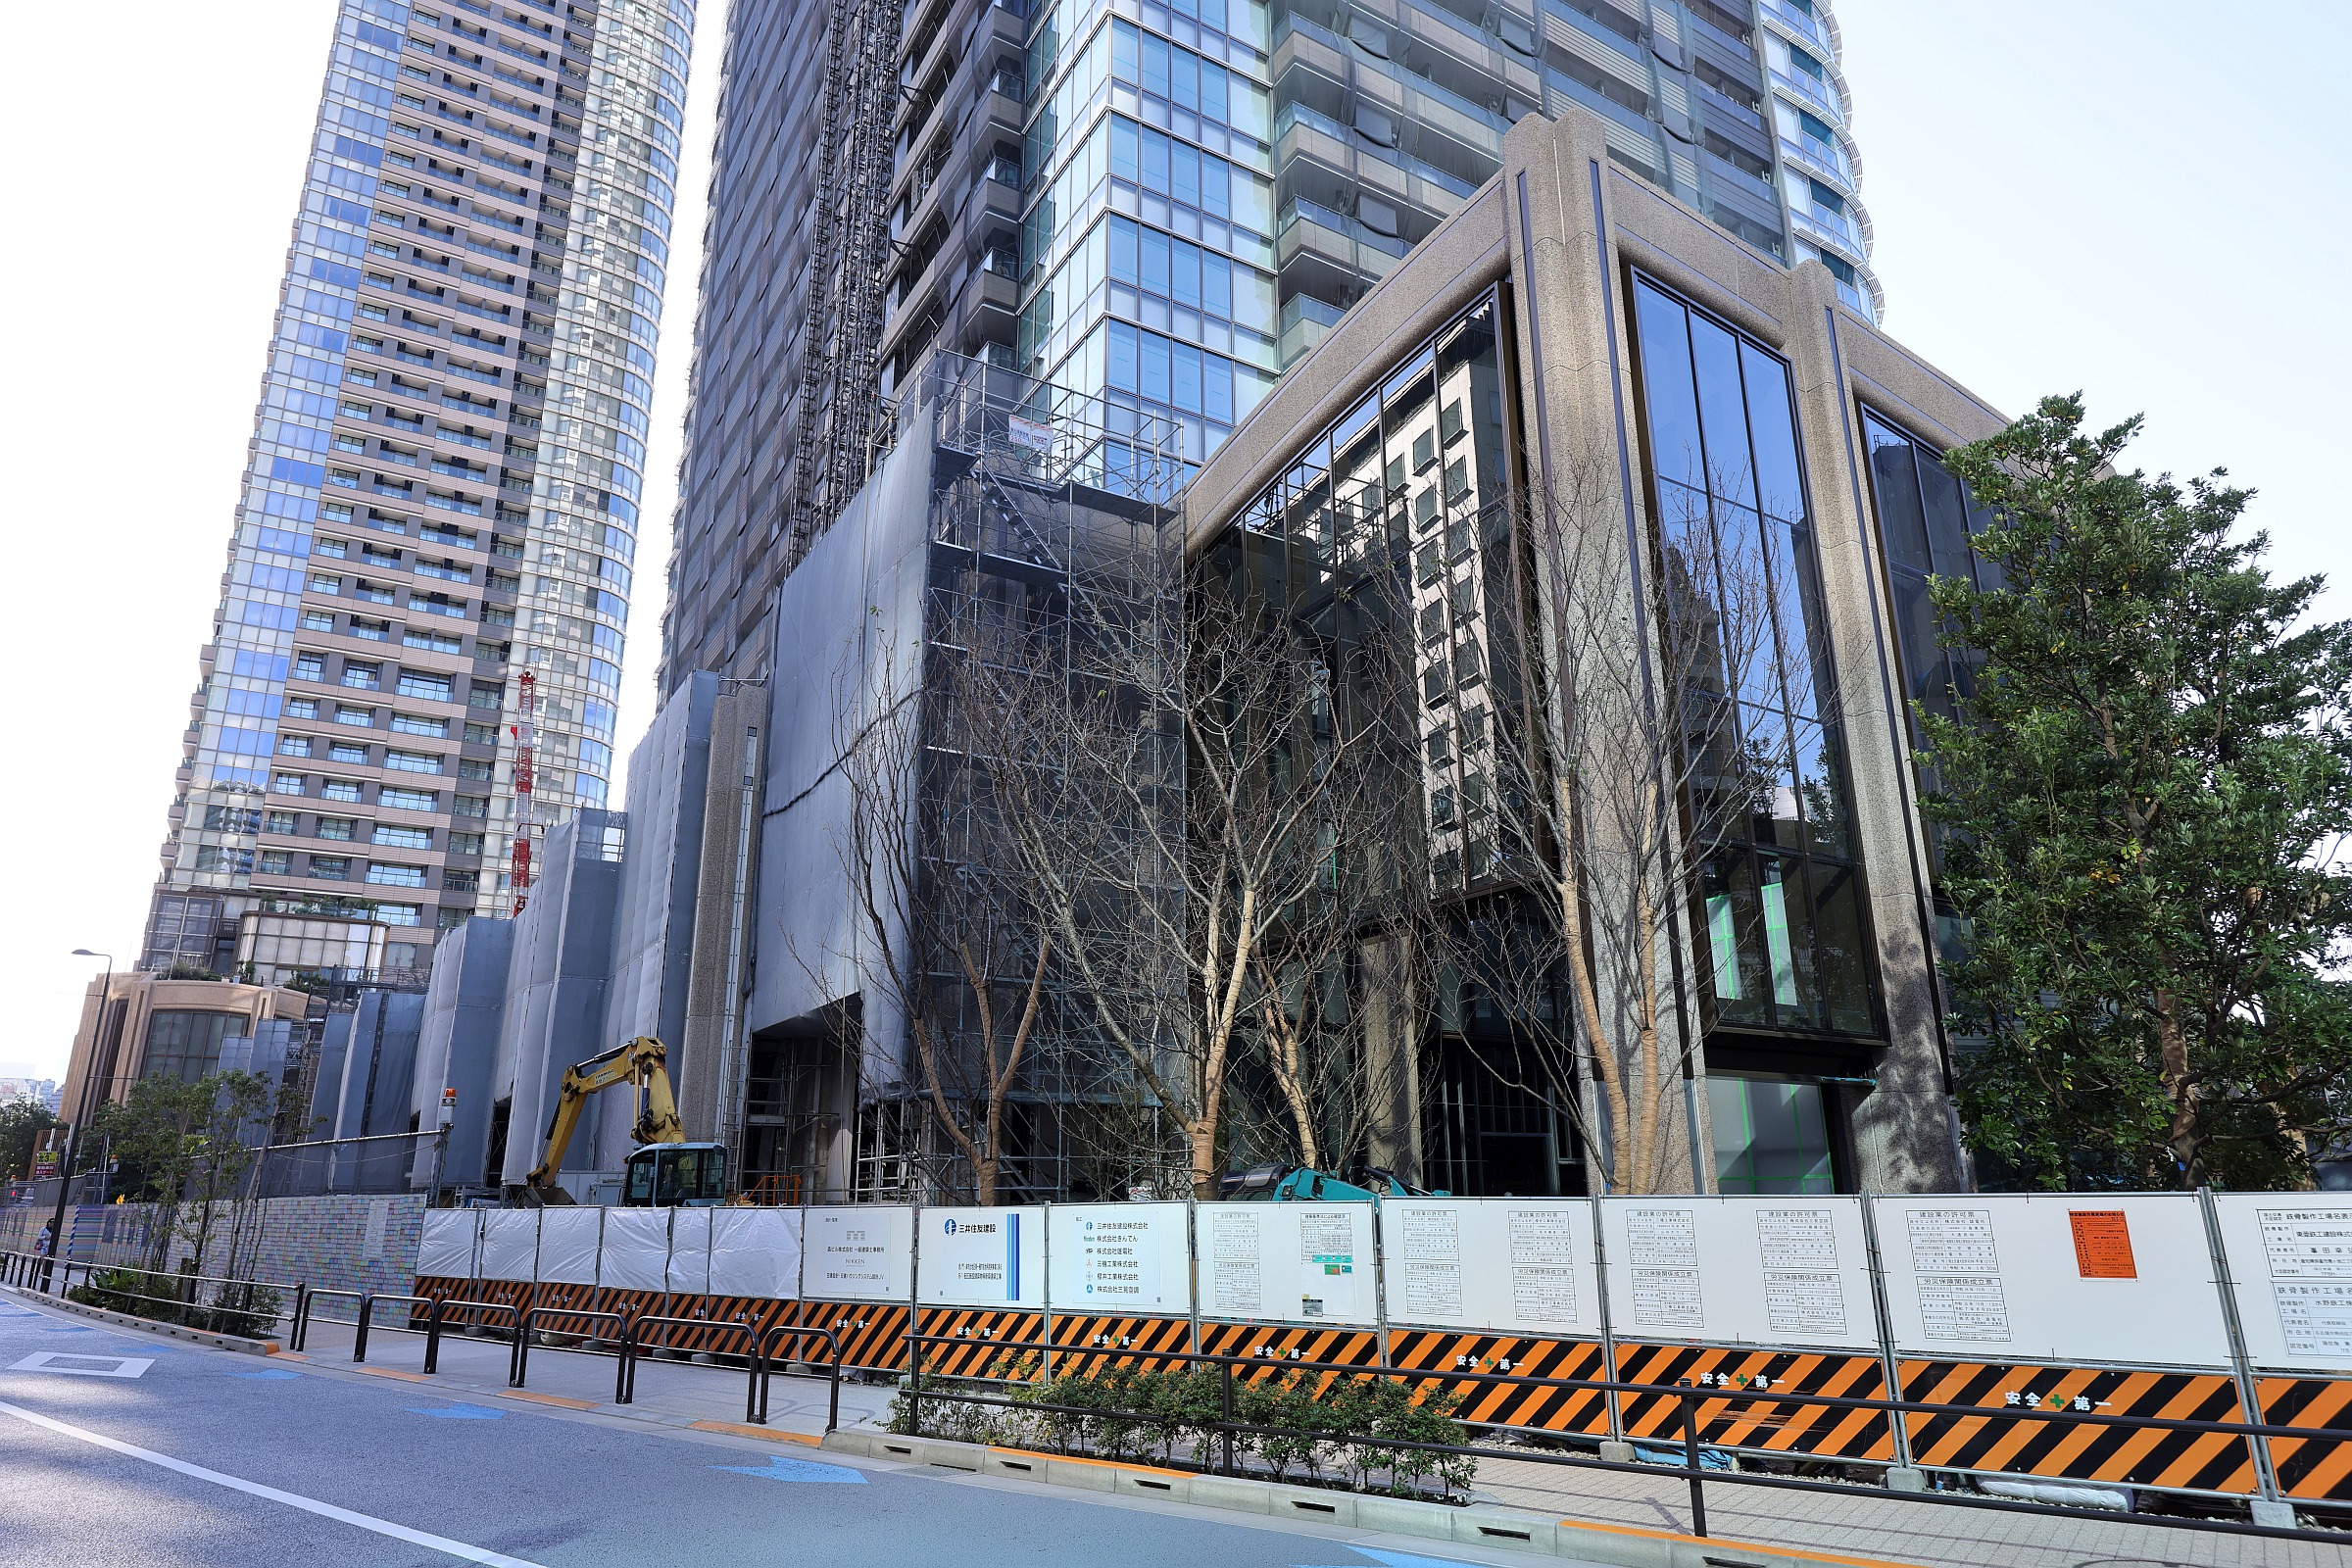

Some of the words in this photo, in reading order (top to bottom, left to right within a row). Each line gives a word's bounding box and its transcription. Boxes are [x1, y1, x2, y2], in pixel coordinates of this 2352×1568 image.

[959, 1224, 997, 1234] 三井住友建設
[836, 1319, 849, 1328] 安全
[858, 1320, 871, 1329] 第一
[956, 1326, 971, 1336] 安全
[983, 1328, 1000, 1337] 第一
[1093, 1334, 1110, 1345] 安全
[1122, 1336, 1139, 1347] 第一
[1254, 1345, 1274, 1356] 安全
[1291, 1348, 1311, 1359] 第一
[1456, 1354, 1480, 1368] 安全
[1499, 1357, 1525, 1371] 第一
[1700, 1371, 1730, 1386] 安全
[1755, 1374, 1786, 1388] 第一
[2004, 1391, 2041, 1407] 安全
[2074, 1396, 2112, 1411] 第一
